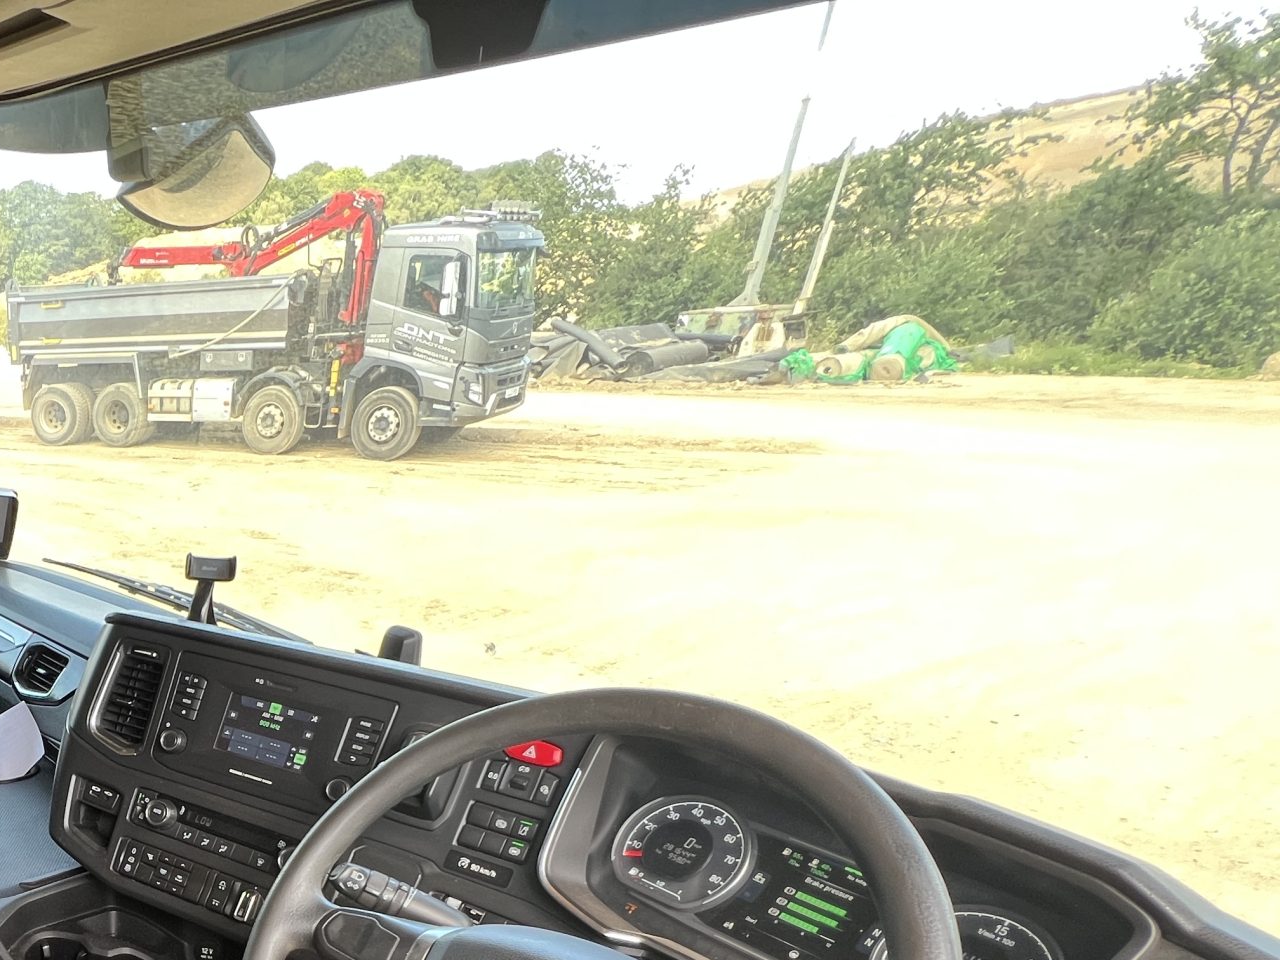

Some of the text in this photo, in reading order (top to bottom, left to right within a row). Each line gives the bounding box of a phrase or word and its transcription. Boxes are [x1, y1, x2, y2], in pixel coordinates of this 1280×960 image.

[406, 234, 461, 243] GRAB HIRE
[399, 322, 458, 344] DNT
[393, 330, 456, 354] CONTRACTORS
[667, 811, 680, 820] 30
[691, 808, 704, 817] 40
[713, 816, 726, 826] 50
[724, 834, 736, 843] 60
[631, 840, 642, 848] 10
[724, 855, 735, 864] 70
[470, 863, 496, 878] 90 km/h
[709, 875, 721, 884] 80
[805, 876, 854, 901] Brake pressure
[872, 928, 882, 937] N
[994, 924, 1010, 936] 15
[864, 938, 875, 947] N
[1001, 937, 1016, 947] 100
